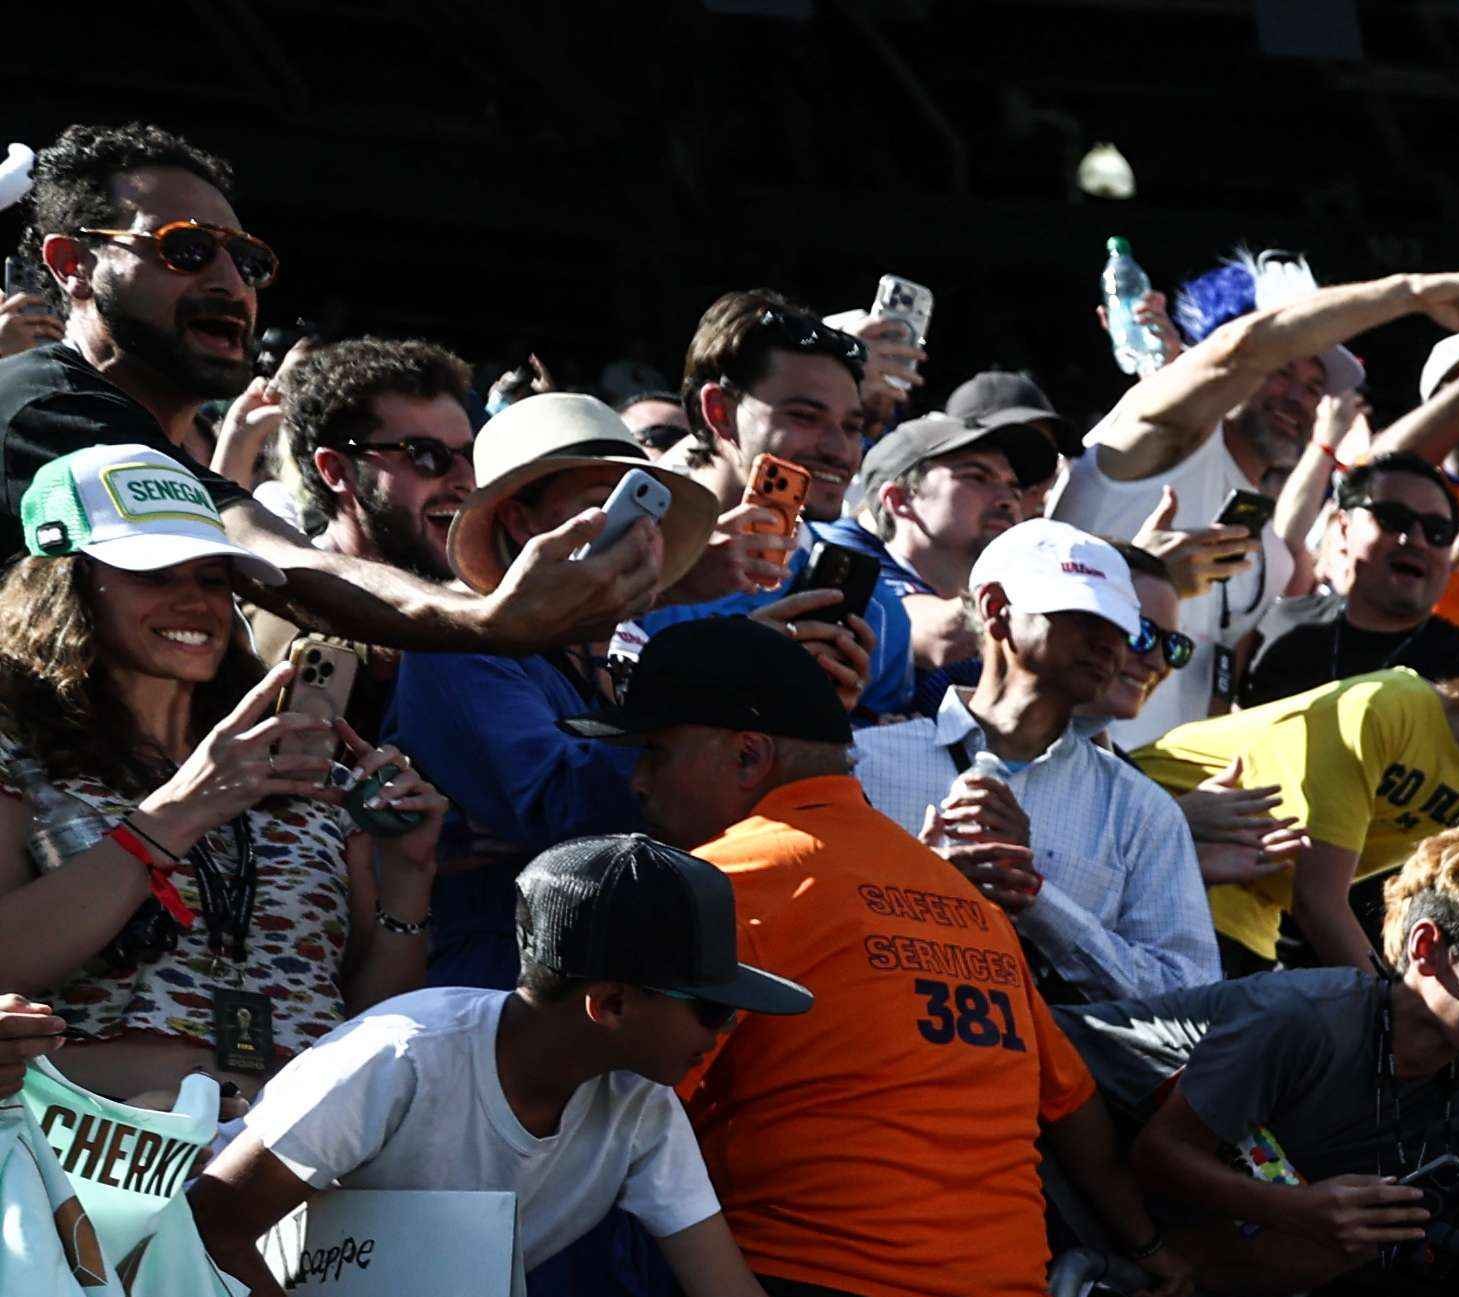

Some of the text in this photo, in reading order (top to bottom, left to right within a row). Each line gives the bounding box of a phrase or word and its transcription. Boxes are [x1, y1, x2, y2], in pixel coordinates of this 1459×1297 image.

[858, 884, 988, 932] SAFETY
[864, 934, 1021, 987] SERVICES
[914, 978, 1026, 1052] 381
[41, 1103, 199, 1199] CHERKI
